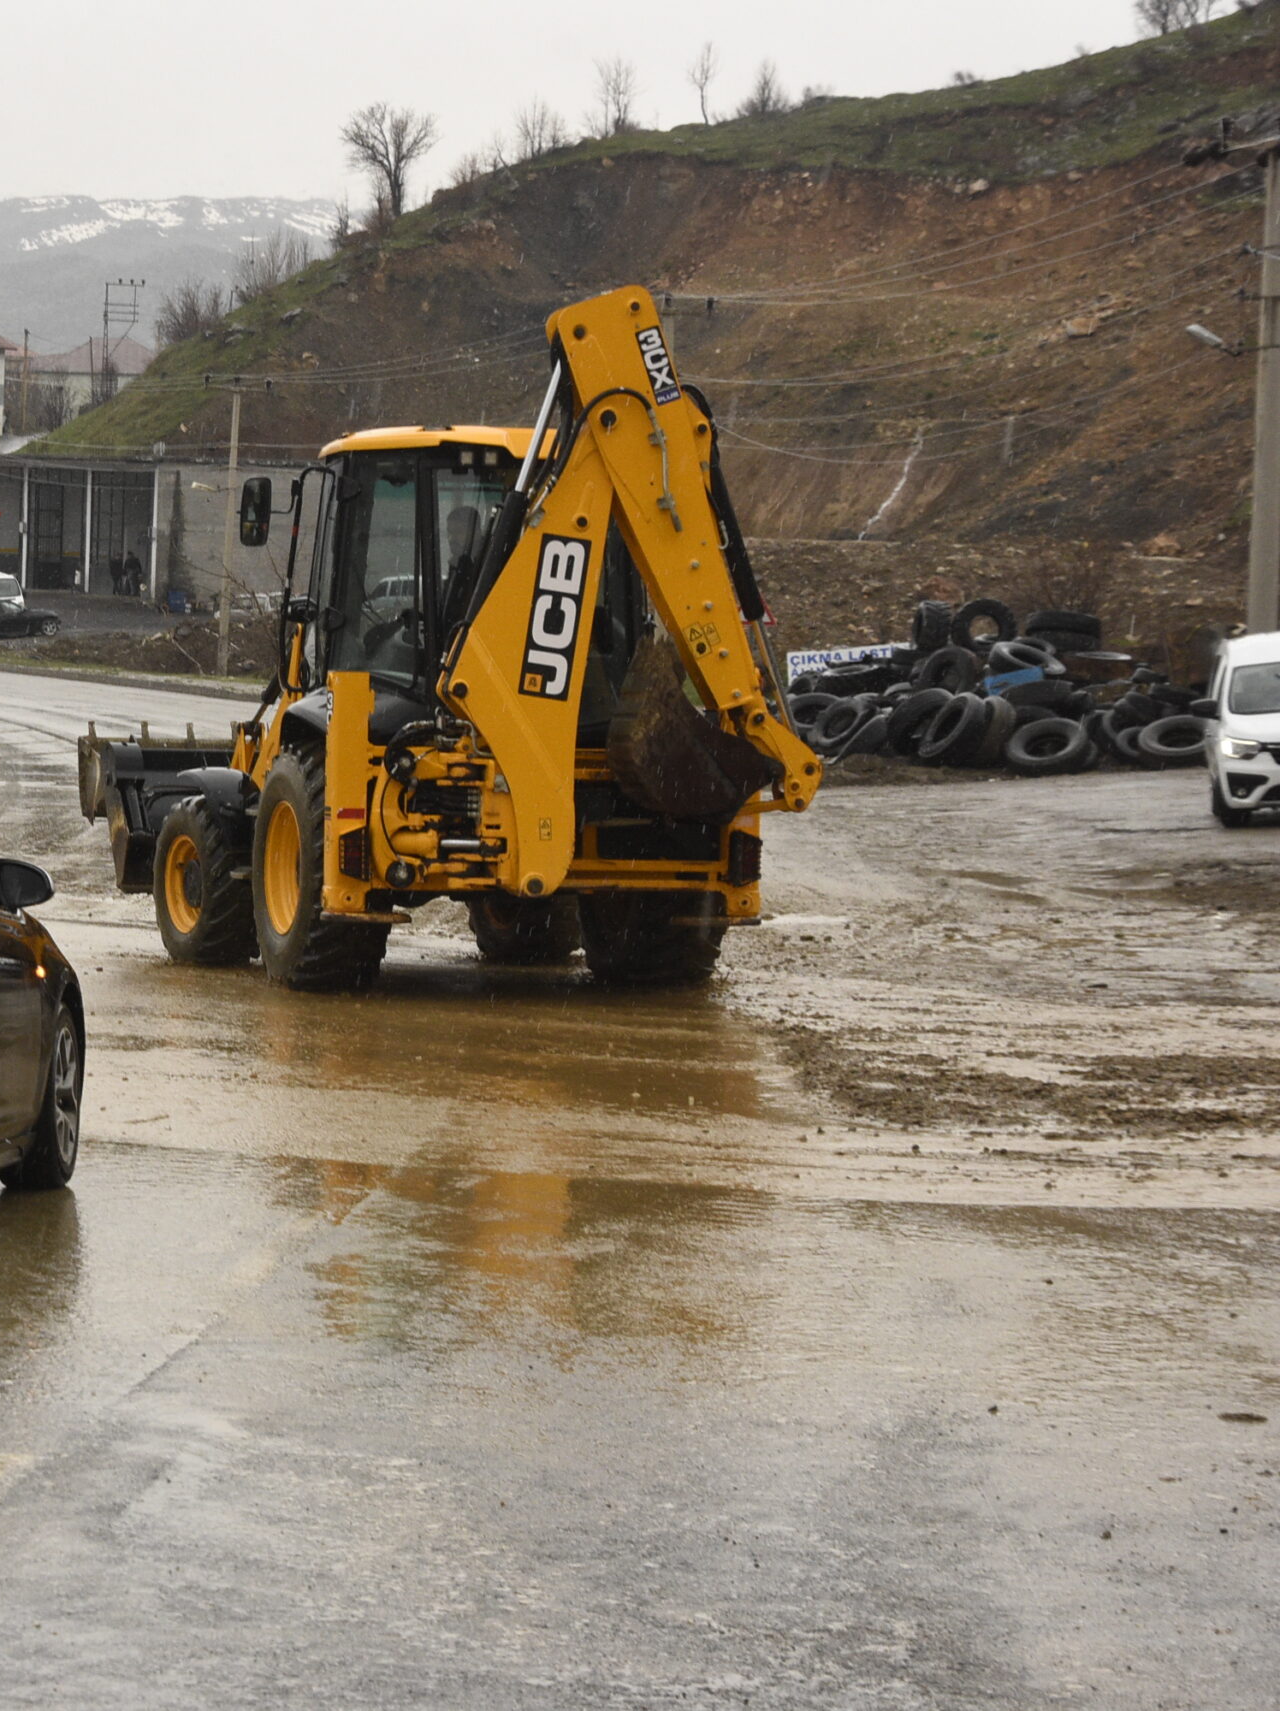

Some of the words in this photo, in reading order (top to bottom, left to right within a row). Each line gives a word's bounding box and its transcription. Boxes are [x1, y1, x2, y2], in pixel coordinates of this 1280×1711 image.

[638, 327, 675, 390] 3CX
[657, 390, 680, 404] PLUS
[527, 539, 586, 696] JCB
[790, 651, 843, 667] ÇIKMA
[848, 645, 896, 661] LASTİ
